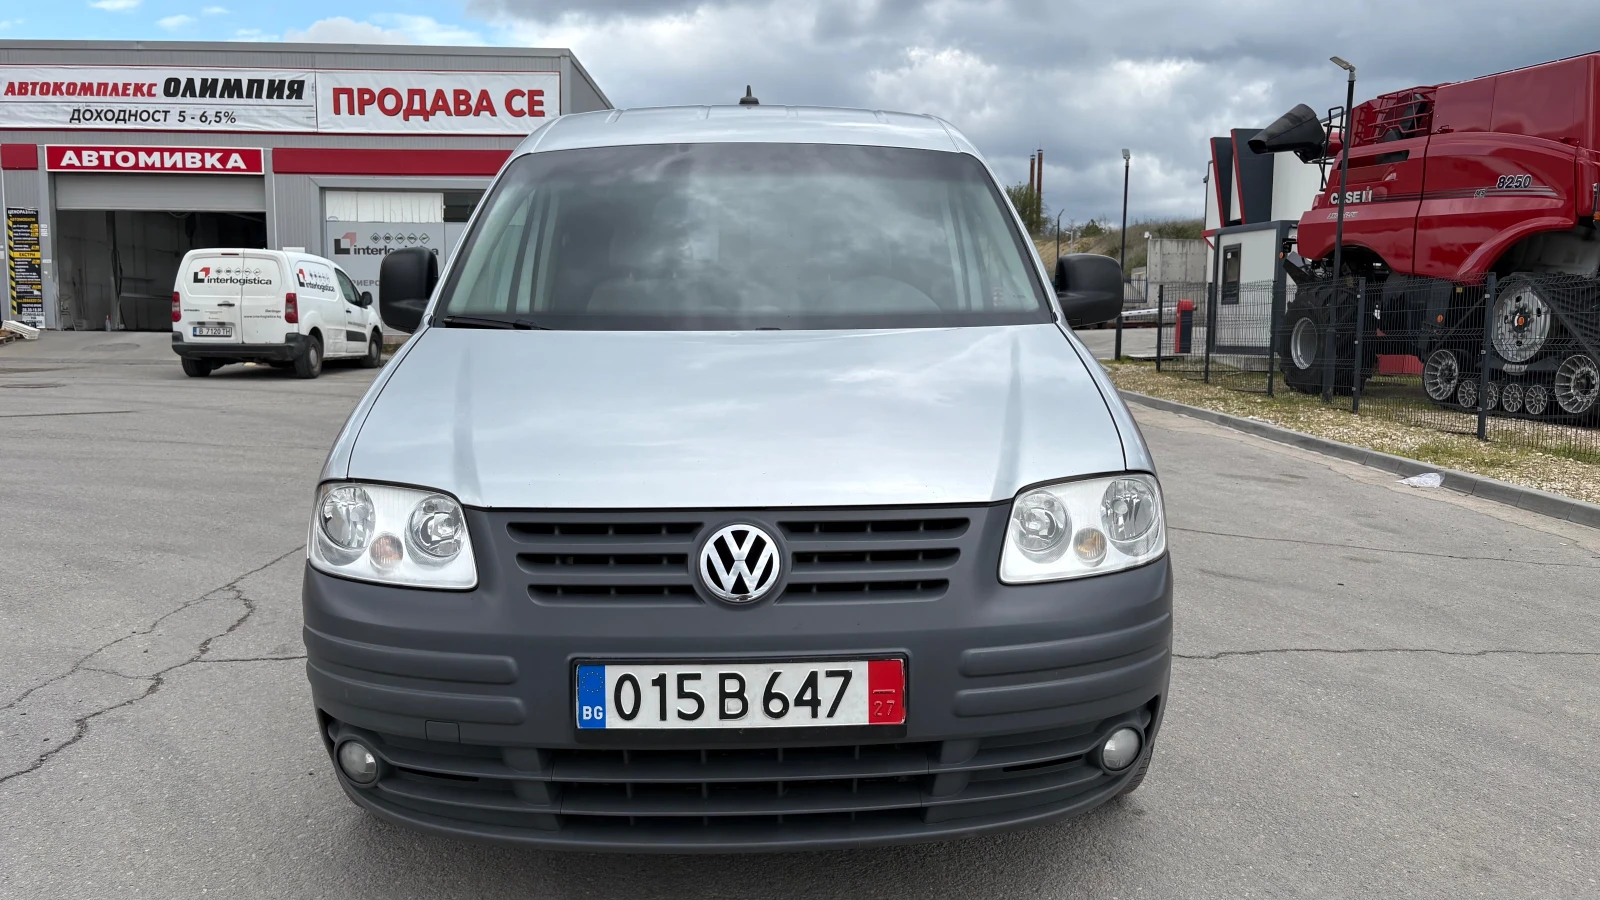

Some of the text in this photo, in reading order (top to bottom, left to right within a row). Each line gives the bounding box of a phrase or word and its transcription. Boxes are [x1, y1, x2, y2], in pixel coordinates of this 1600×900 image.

[4, 81, 157, 97] АВТОКОМПЛЕКС
[163, 77, 305, 100] ОЛИМПИЯ
[332, 87, 497, 121] ПРОДАВА
[504, 89, 545, 117] СЕ
[69, 108, 170, 124] ДОХОДНОСТ
[177, 110, 186, 123] 5
[199, 110, 237, 125] 6,5%
[60, 150, 247, 170] АВТОМИВКА
[1496, 174, 1532, 189] 8250
[1330, 191, 1361, 205] CSE
[354, 245, 439, 255] interloa
[207, 276, 272, 285] interlogistica
[582, 706, 604, 720] BG
[873, 700, 895, 716] 27
